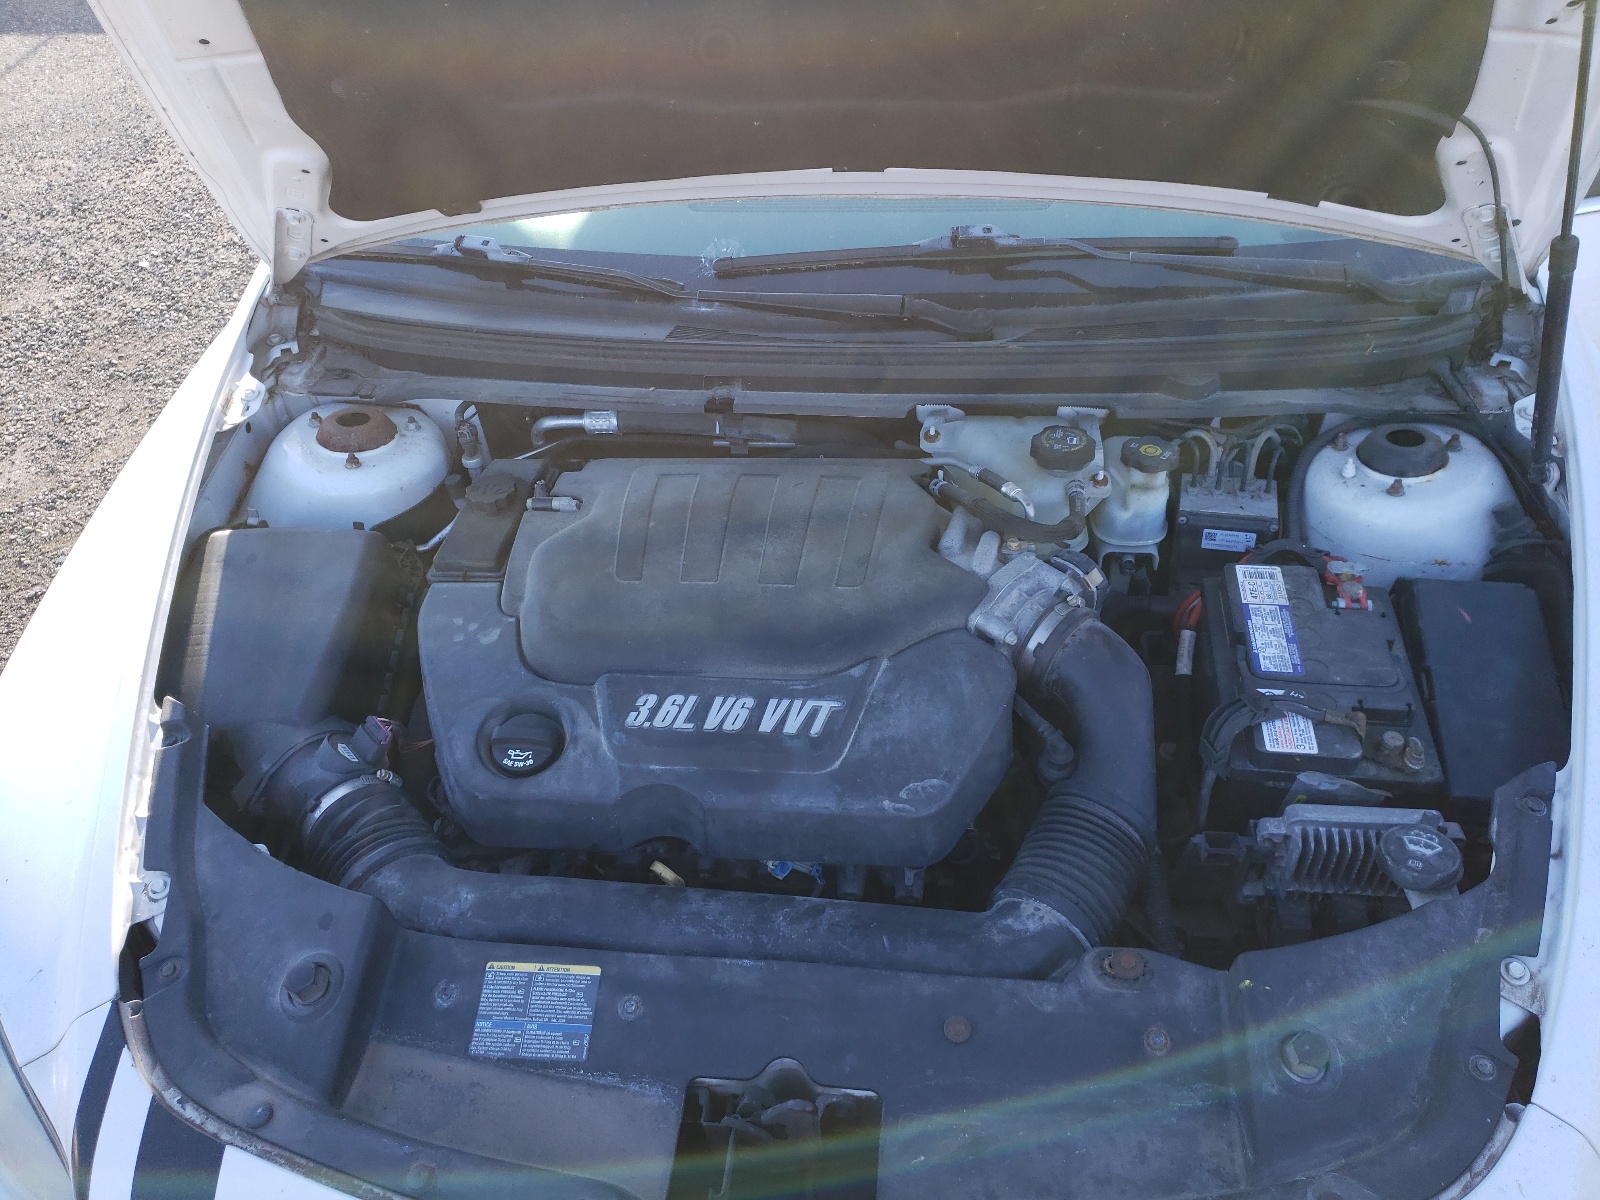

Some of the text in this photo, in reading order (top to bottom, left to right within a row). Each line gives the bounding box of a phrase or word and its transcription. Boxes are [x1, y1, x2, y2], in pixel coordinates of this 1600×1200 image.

[625, 693, 846, 737] 3.6L V6 VVT
[502, 758, 534, 767] SAE 5W-30
